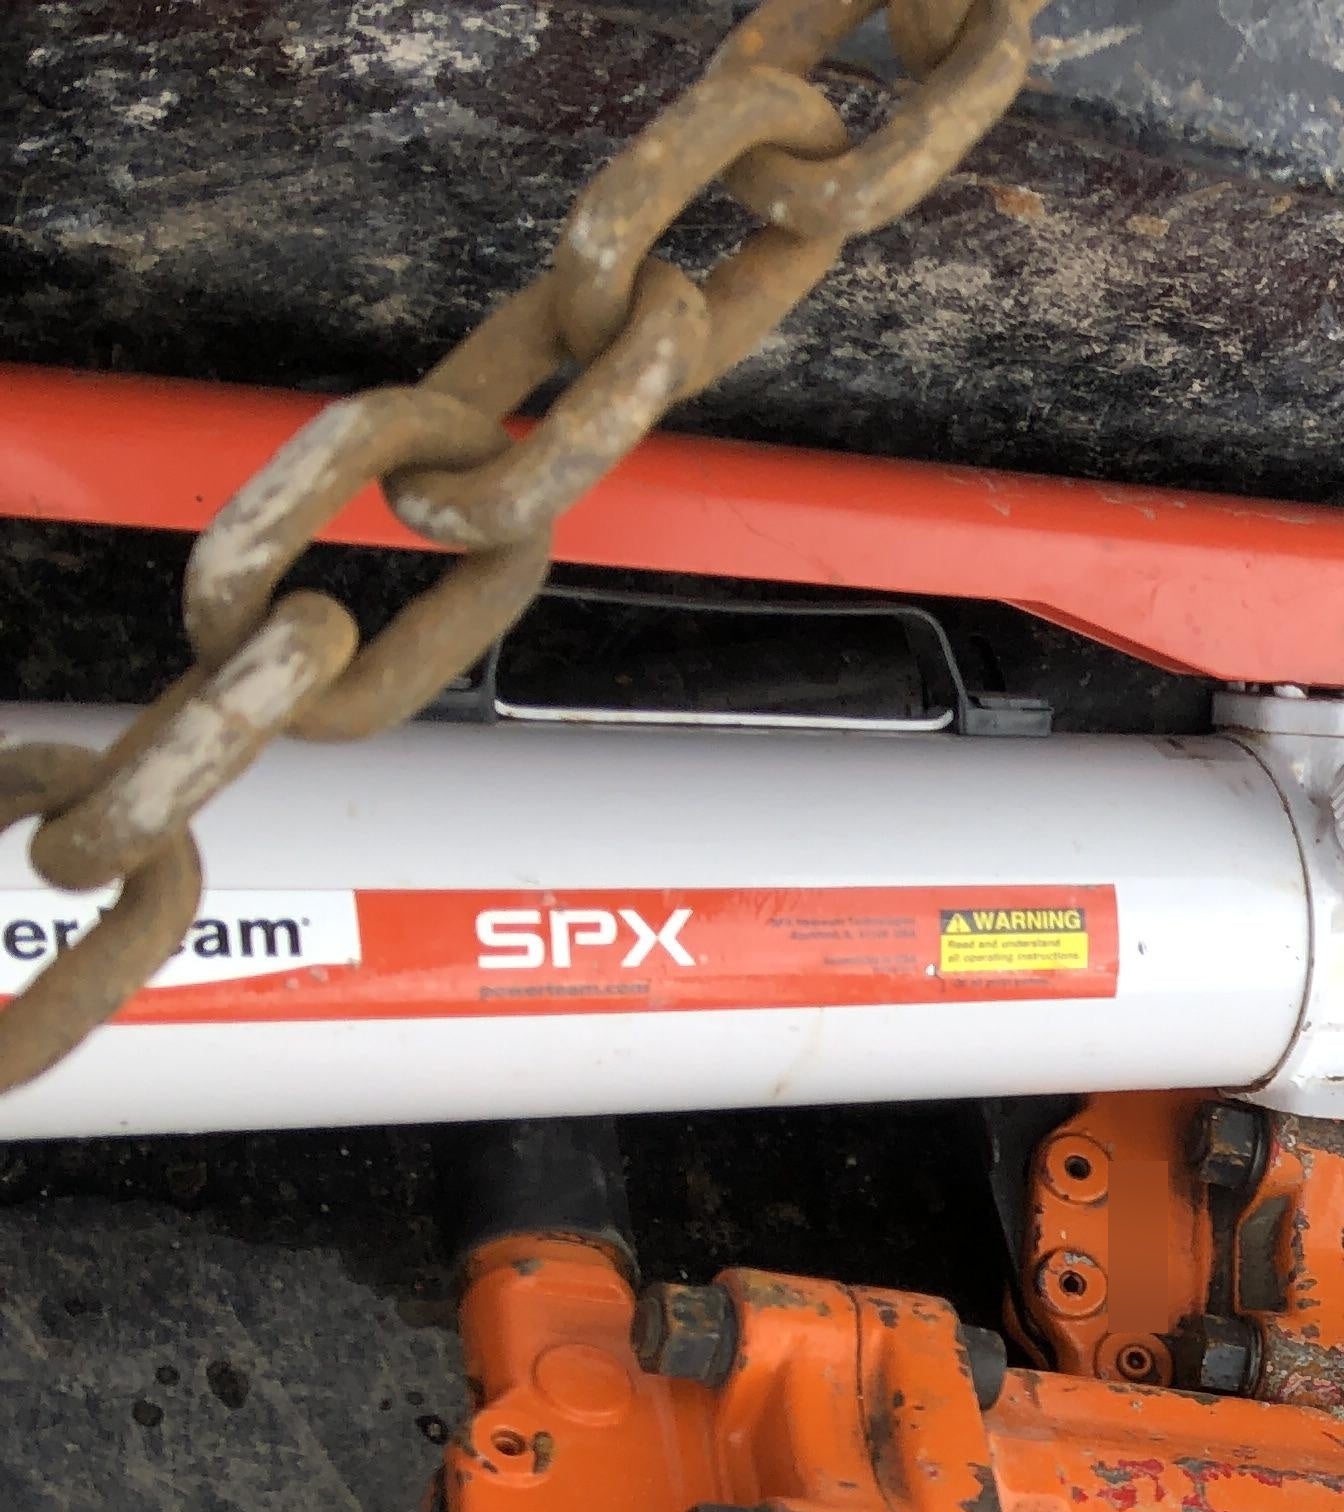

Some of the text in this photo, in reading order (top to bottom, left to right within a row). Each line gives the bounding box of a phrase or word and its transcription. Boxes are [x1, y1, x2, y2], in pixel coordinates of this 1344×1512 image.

[971, 909, 1082, 931] WARNING
[178, 916, 304, 958] am
[475, 907, 697, 969] SPX
[978, 939, 998, 948] and
[1001, 939, 1061, 948] understand
[963, 952, 1014, 964] operating
